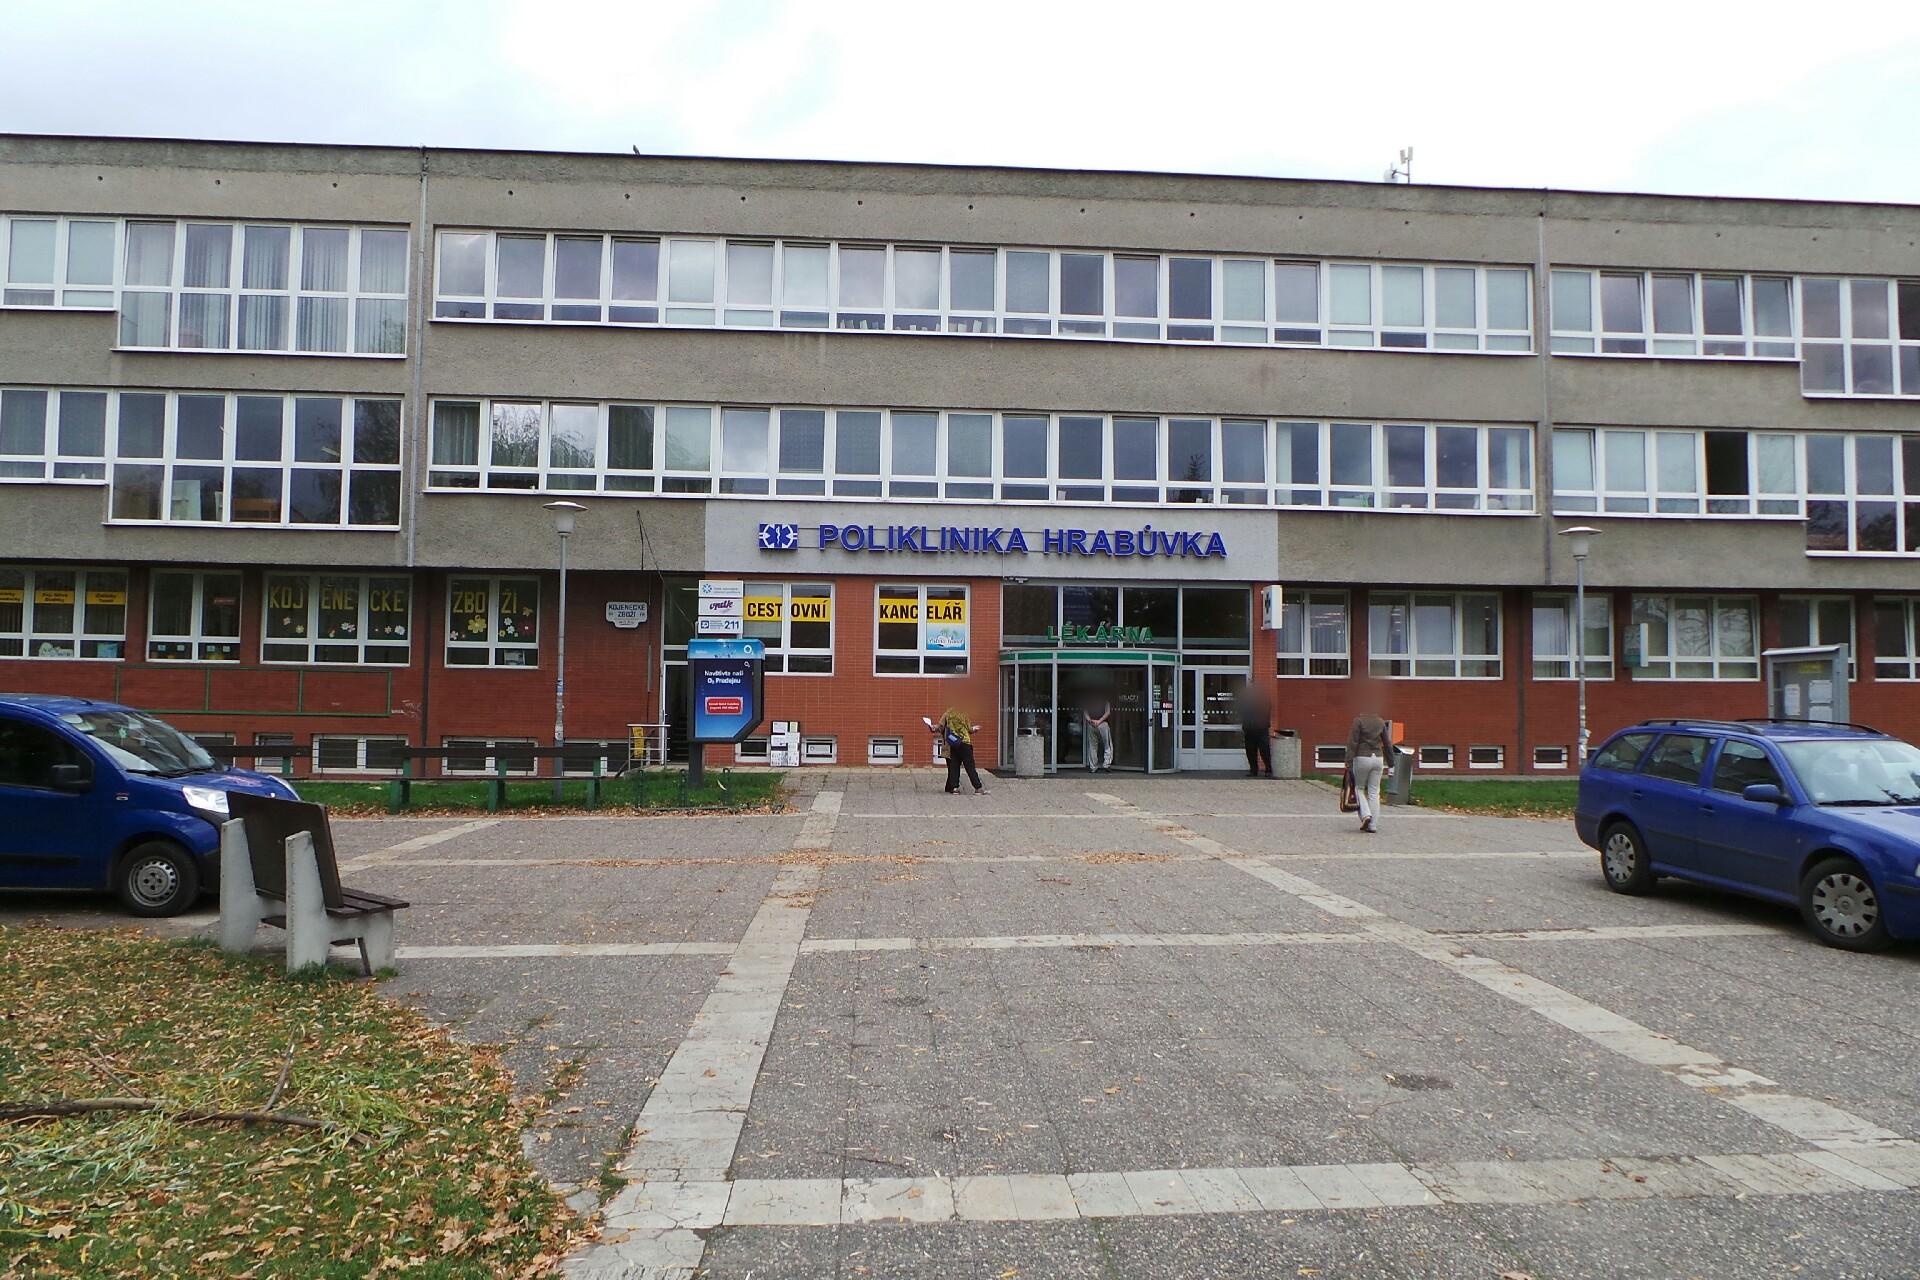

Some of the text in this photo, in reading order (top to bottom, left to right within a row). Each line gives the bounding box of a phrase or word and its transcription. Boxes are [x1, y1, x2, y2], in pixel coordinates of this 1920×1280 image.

[819, 524, 1227, 557] POLIKLINIKA HRABŮVKA
[747, 599, 828, 618] CESTOVNÍ
[879, 602, 962, 620] KANCELÁŘ
[724, 620, 739, 630] 211
[1046, 619, 1153, 643] LÉKÁRNA
